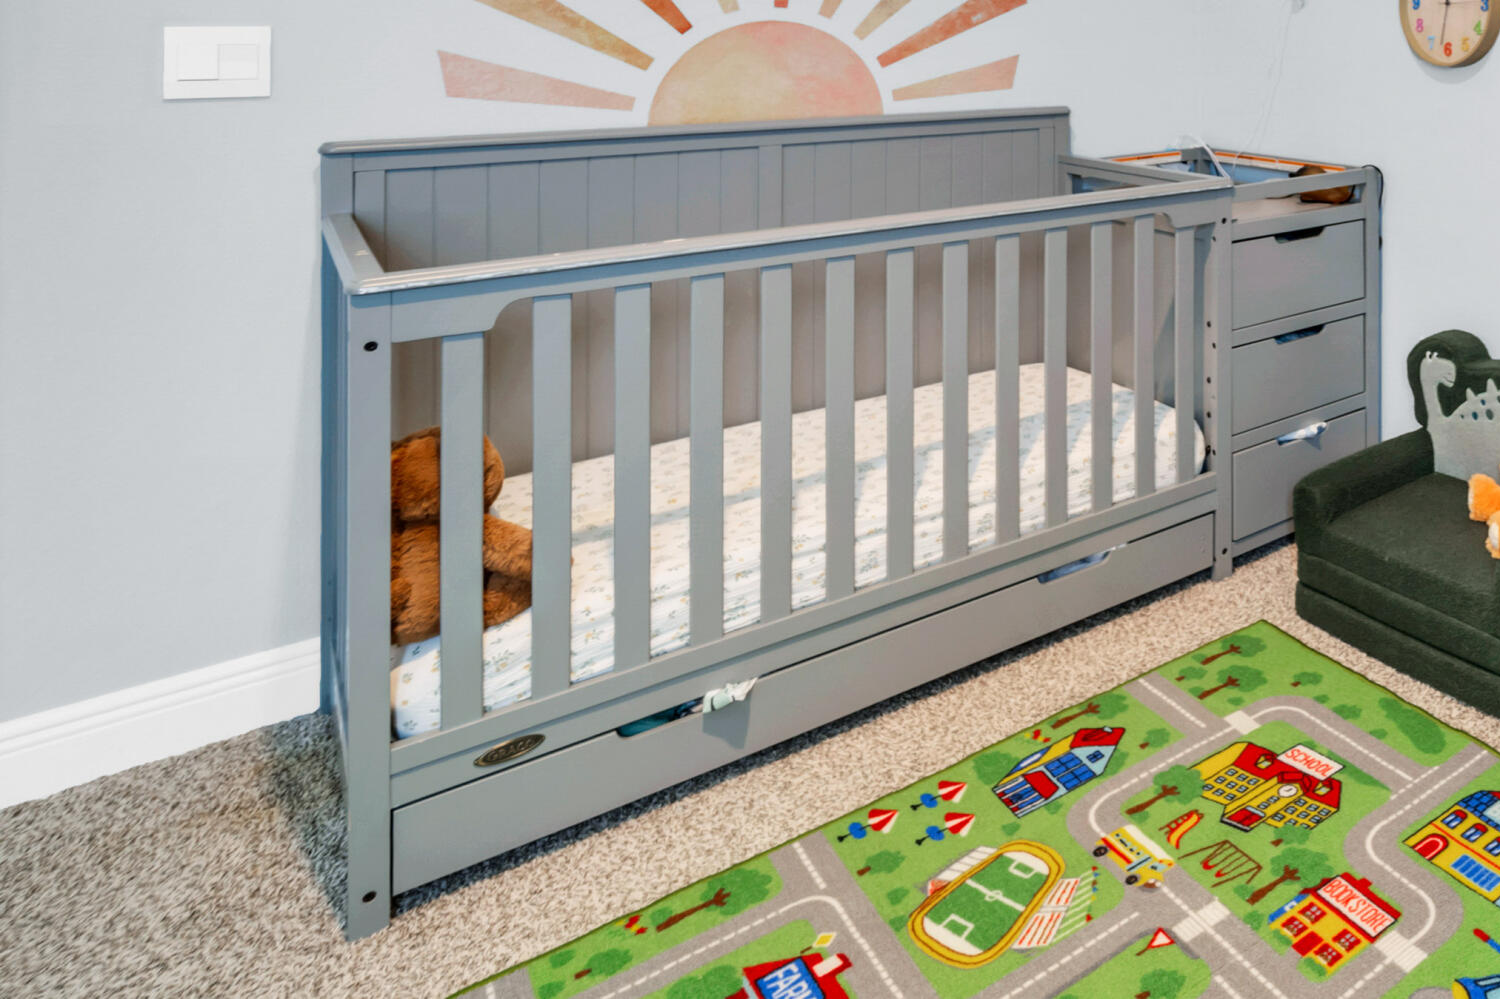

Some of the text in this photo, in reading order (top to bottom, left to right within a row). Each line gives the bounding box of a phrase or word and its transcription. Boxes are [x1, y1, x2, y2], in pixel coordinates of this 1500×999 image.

[1415, 18, 1424, 33] 8
[1473, 20, 1483, 35] 4
[1427, 36, 1435, 50] 7
[1443, 42, 1453, 57] 6
[1461, 37, 1470, 52] 5
[1284, 748, 1334, 777] SCHOOL
